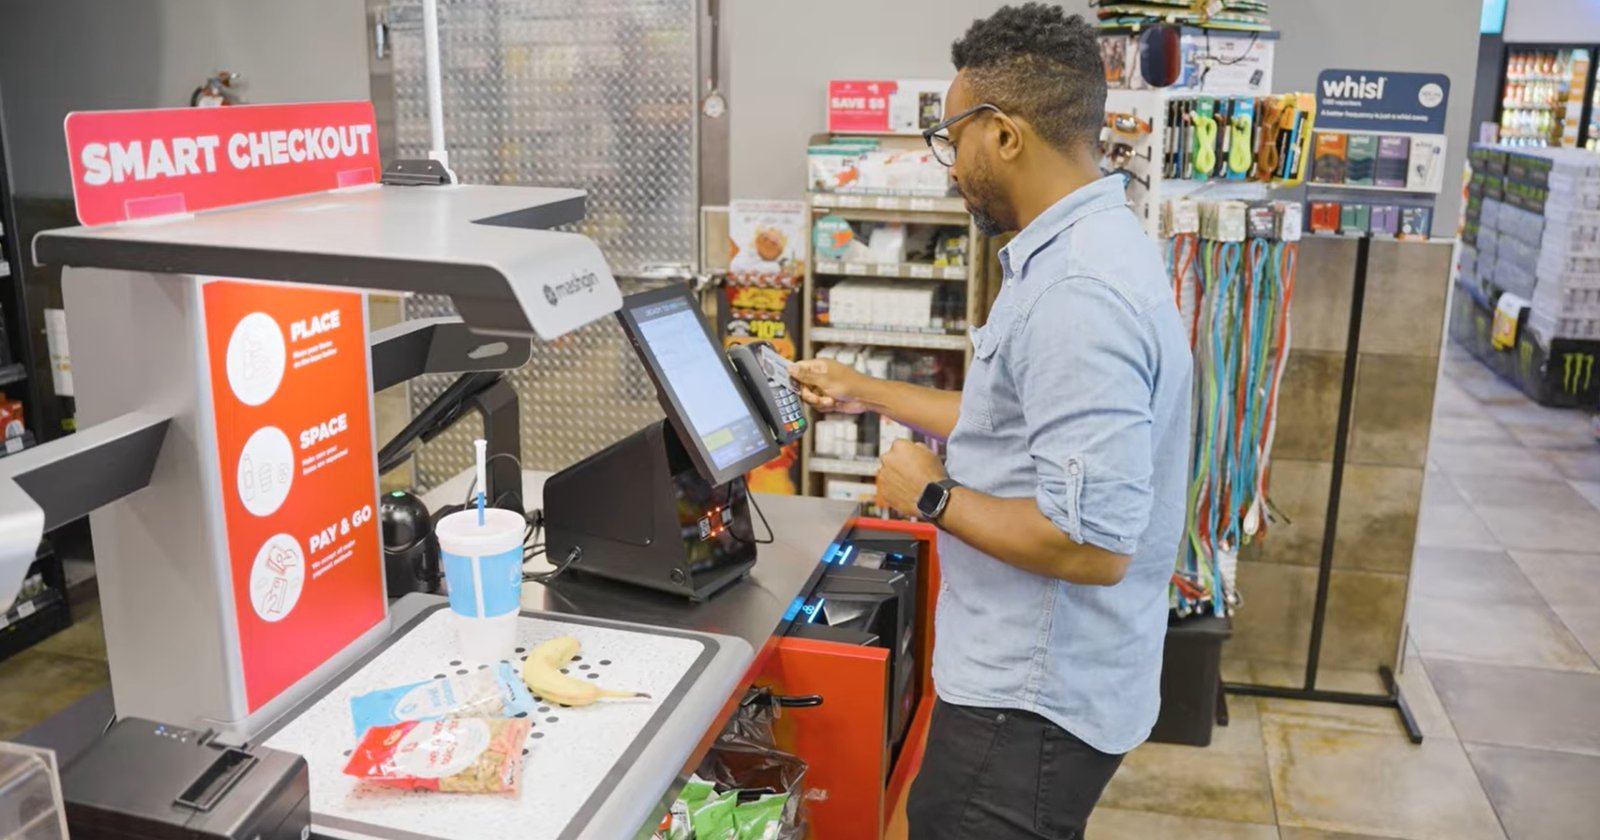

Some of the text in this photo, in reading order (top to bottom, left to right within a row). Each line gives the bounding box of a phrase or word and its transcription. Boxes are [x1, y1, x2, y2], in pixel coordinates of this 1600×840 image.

[831, 97, 865, 110] SAVE
[1322, 75, 1385, 100] whisl
[80, 123, 373, 187] SMART CHECKOUT
[555, 268, 600, 298] mashgin
[290, 309, 341, 342] PLACE
[300, 412, 348, 449] SPACE
[309, 504, 372, 553] PAY & GO
